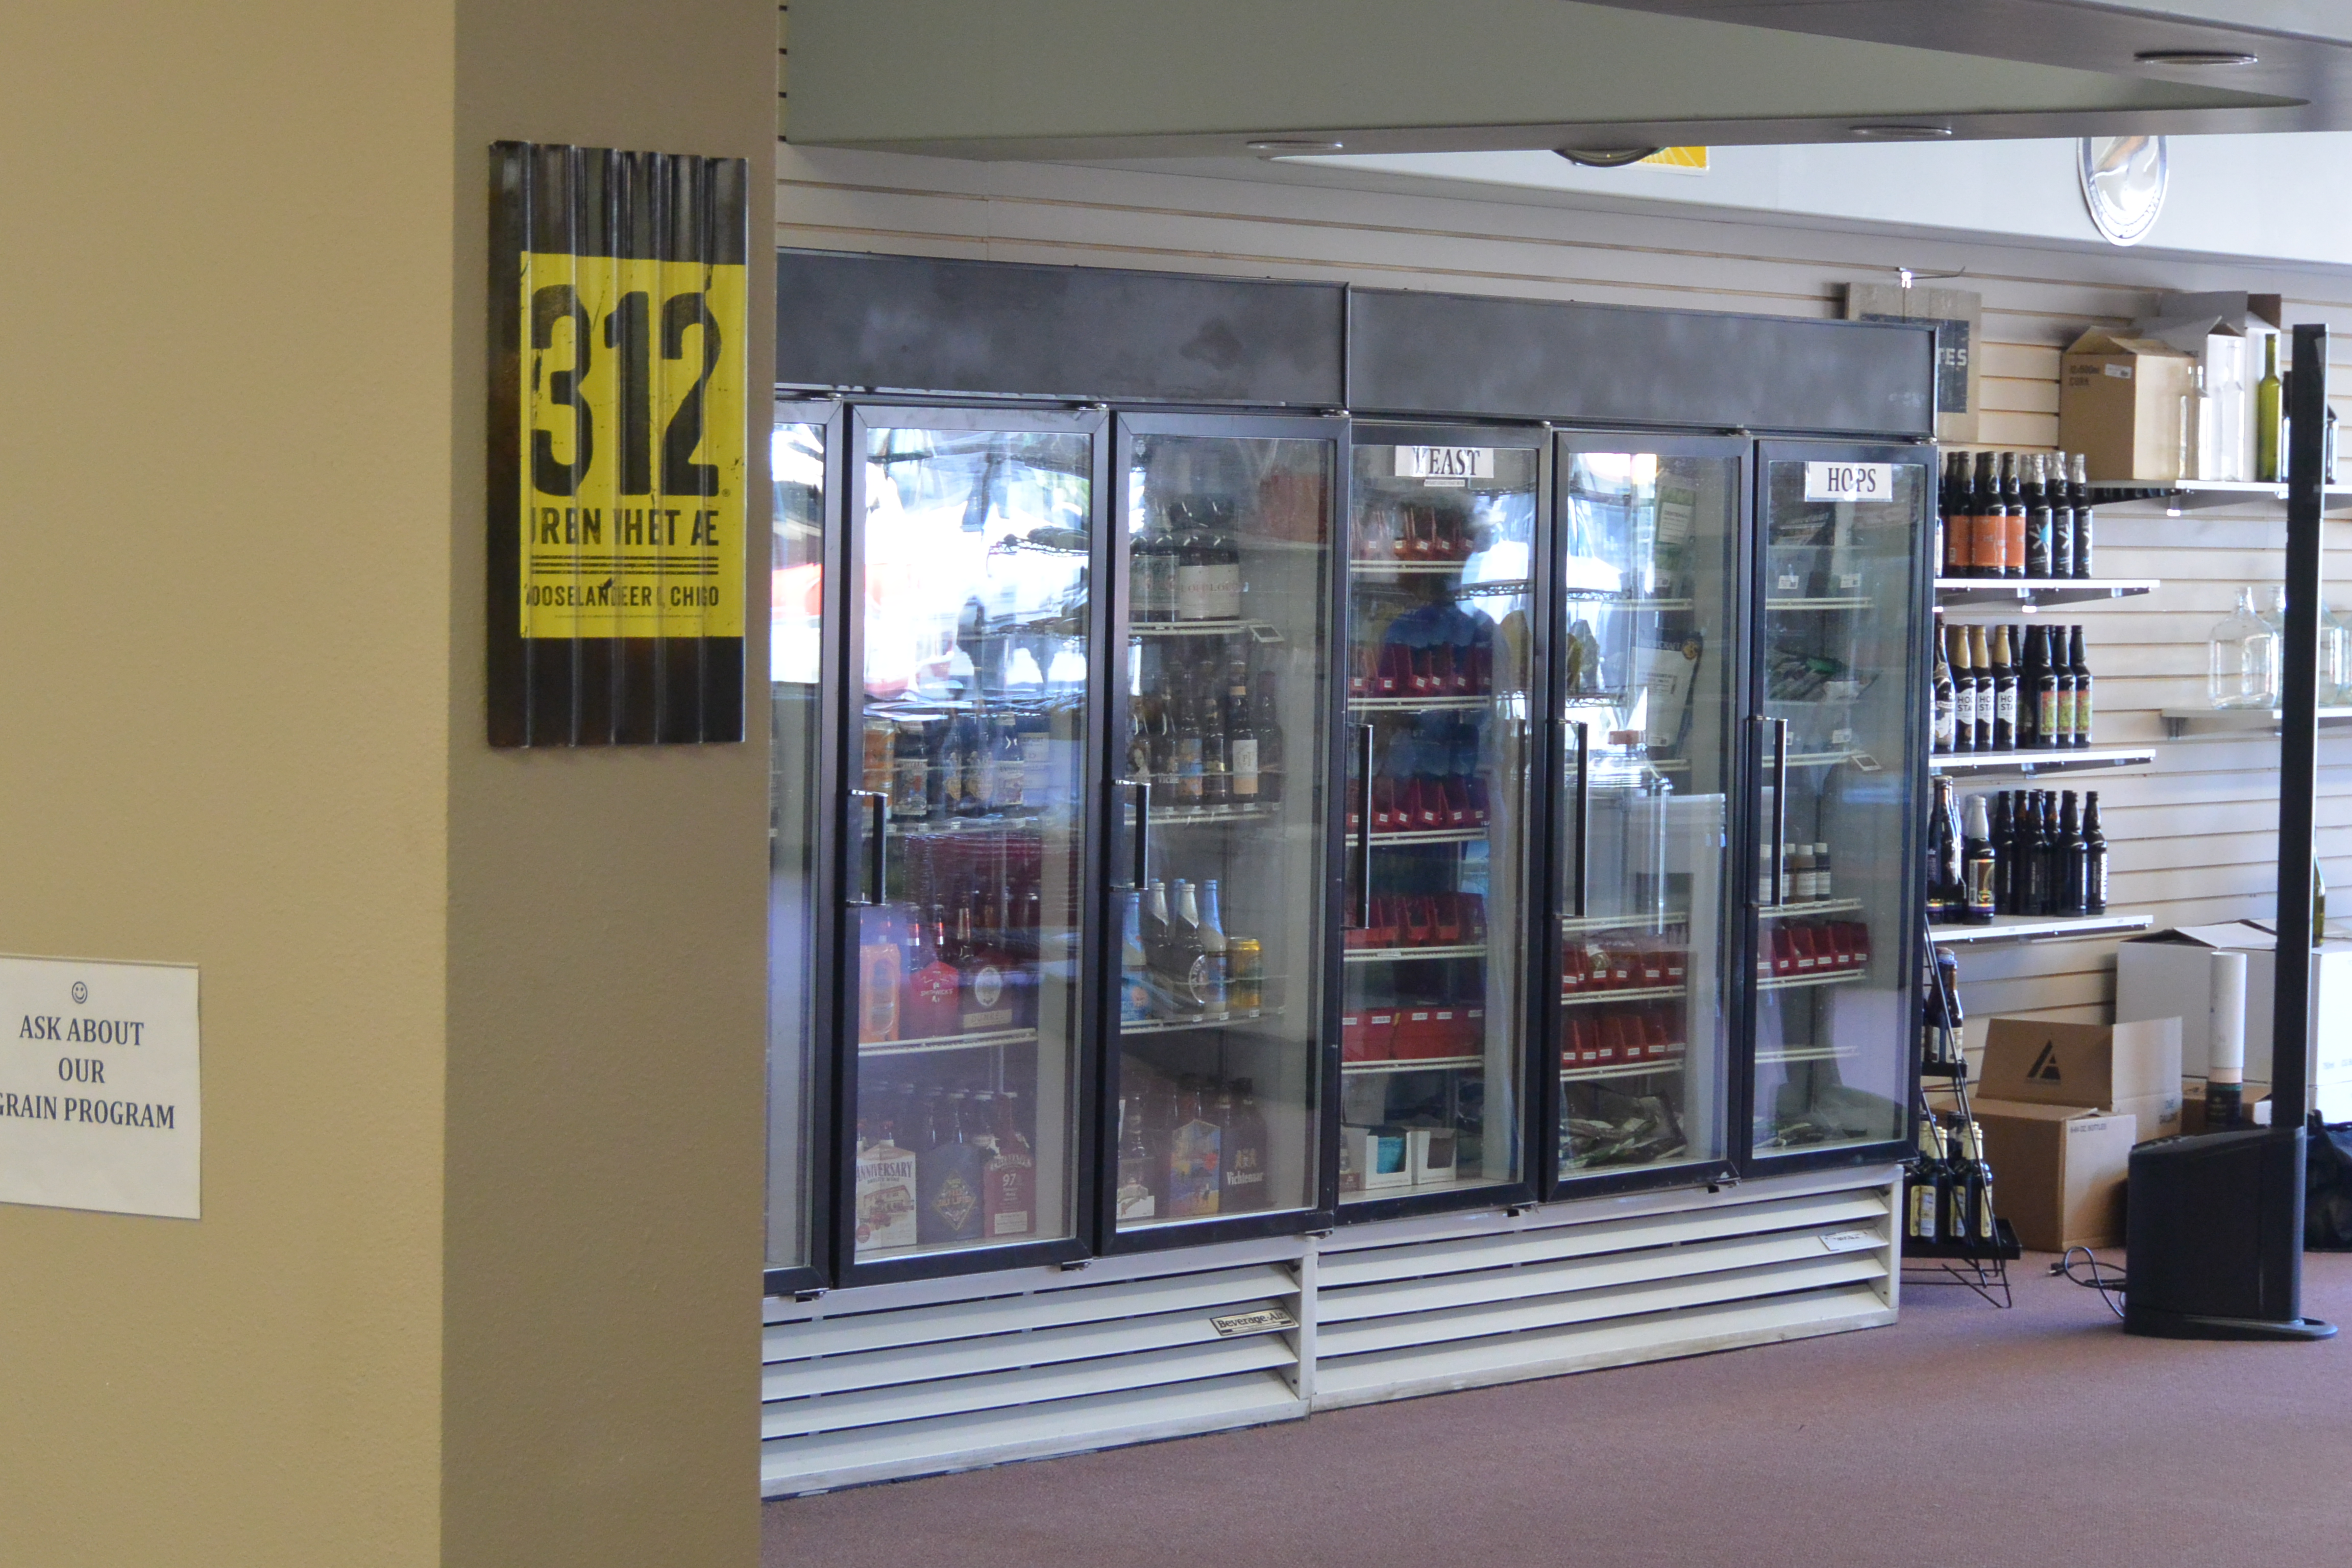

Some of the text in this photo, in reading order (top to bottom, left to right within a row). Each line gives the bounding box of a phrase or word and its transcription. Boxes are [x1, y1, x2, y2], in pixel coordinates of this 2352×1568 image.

[531, 284, 721, 497] 312
[1412, 447, 1481, 476] YEAST
[1827, 468, 1876, 493] HOPS
[19, 1014, 144, 1046] ASK ABOUT
[58, 1057, 106, 1084] OUR
[64, 1097, 175, 1129] PROGRAM
[856, 1161, 913, 1182] ANNIVERSARY
[1002, 1173, 1017, 1192] 97
